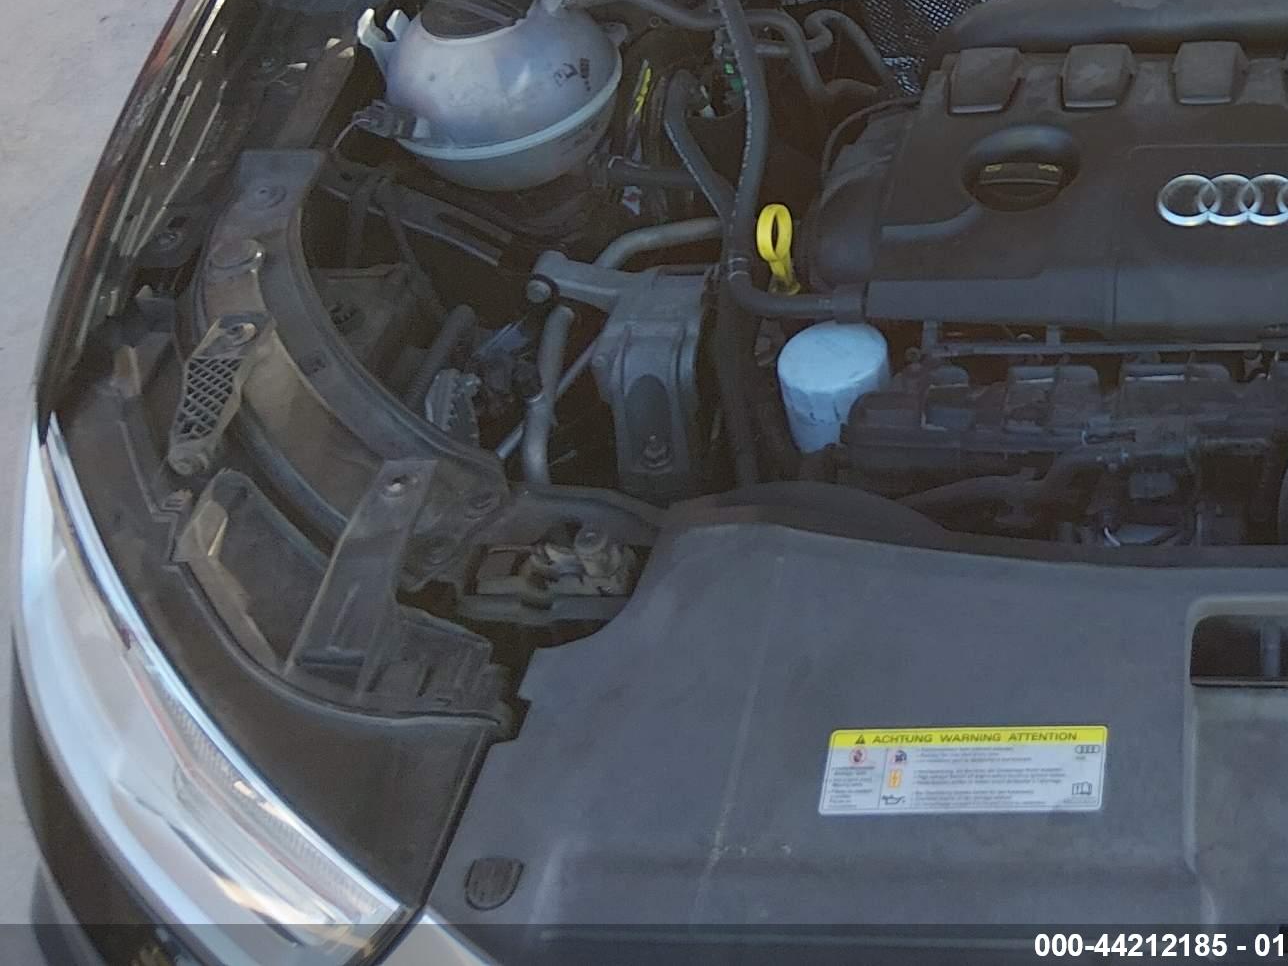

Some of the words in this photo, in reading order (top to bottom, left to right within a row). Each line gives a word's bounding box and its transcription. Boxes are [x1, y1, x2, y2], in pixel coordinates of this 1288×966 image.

[872, 734, 933, 744] ACHTUNG
[939, 732, 1001, 743] WARNING
[1008, 731, 1078, 742] ATTENTION
